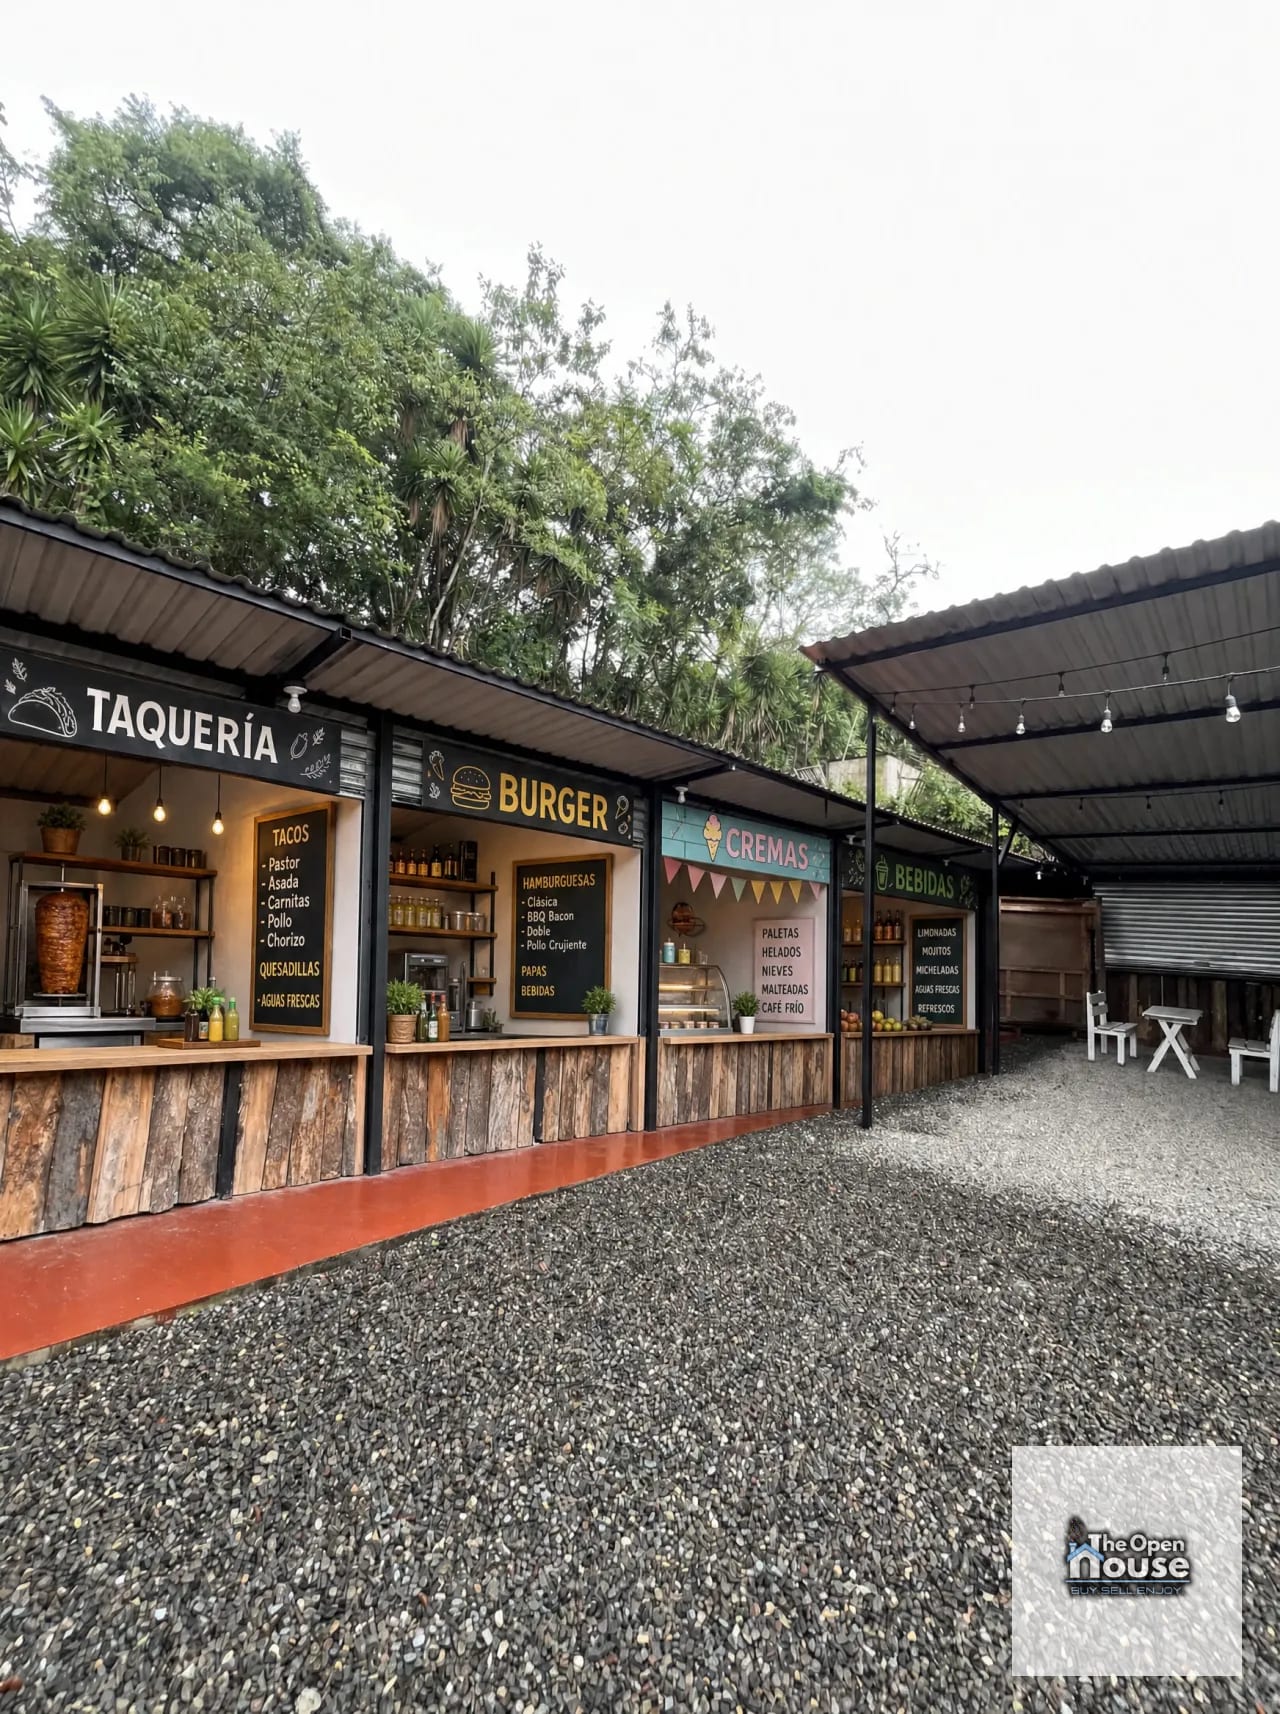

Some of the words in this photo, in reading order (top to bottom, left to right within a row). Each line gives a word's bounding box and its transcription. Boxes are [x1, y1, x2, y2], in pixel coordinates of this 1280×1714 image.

[87, 687, 278, 764] TAQUERÍA
[499, 772, 608, 831] BURGER
[272, 824, 310, 847] TACOS
[726, 827, 810, 871] CREMAS
[268, 857, 301, 872] Pastor
[268, 873, 299, 891] Asada
[523, 873, 596, 890] HAMBURGUESAS
[895, 863, 954, 899] BEBIDAS
[267, 895, 310, 910] Carnitas
[527, 896, 558, 908] Clásica
[267, 912, 293, 929] Pollo
[527, 911, 546, 923] BBQ
[548, 911, 574, 922] Bacon
[527, 926, 551, 937] Doble
[762, 927, 799, 939] PALETAS
[917, 928, 957, 938] LIMONADAS
[267, 931, 305, 948] Chorizo
[527, 940, 547, 951] Pollo
[550, 939, 587, 953] Crujiente
[762, 946, 801, 958] HELADOS
[922, 946, 952, 956] MOJITOS
[260, 961, 320, 980] QUESADILLAS
[521, 965, 547, 977] PAPAS
[762, 965, 793, 977] NIEVES
[916, 965, 959, 975] MICHELADAS
[521, 985, 555, 997] BEBIDAS
[762, 984, 809, 995] MALTEADAS
[915, 985, 934, 994] AGUAS
[935, 985, 960, 994] FRESCAS
[286, 994, 320, 1009] FRESCAS
[761, 1000, 782, 1014] CAFÉ
[785, 1000, 804, 1014] FRÍO
[918, 1004, 955, 1014] REFRESCOS
